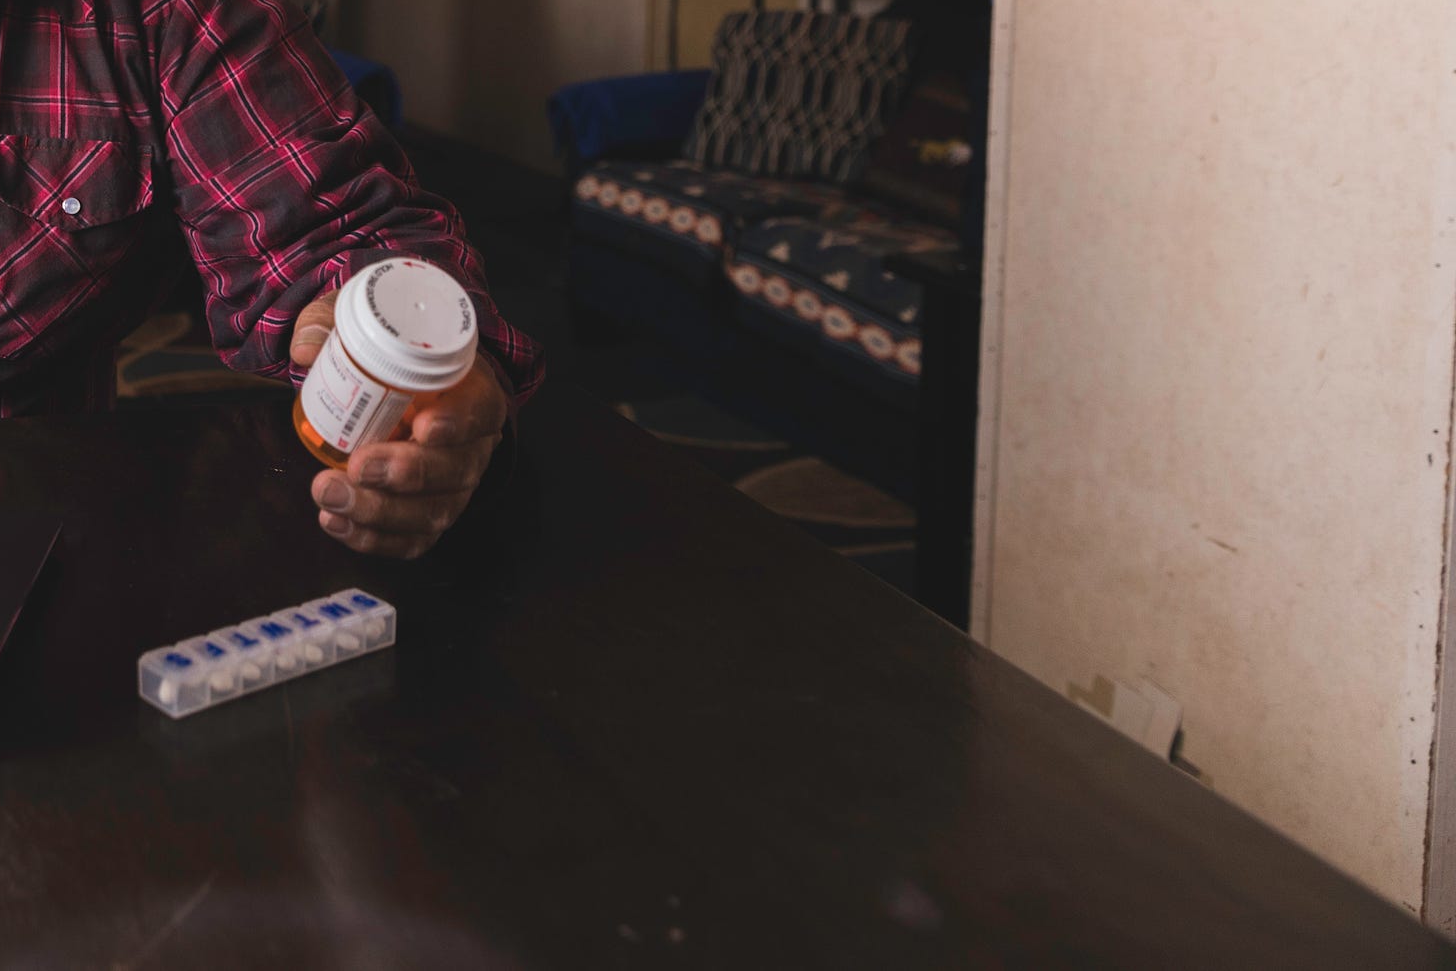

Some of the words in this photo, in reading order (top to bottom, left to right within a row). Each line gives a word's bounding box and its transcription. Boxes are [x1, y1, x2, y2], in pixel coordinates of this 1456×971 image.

[375, 263, 394, 275] HOLD
[366, 287, 378, 310] DOWN
[457, 297, 469, 308] TO
[379, 317, 400, 338] TURN
[460, 309, 472, 334] OPEN
[351, 595, 378, 609] S
[294, 614, 319, 629] T
[234, 633, 259, 648] T
[165, 653, 193, 669] S
